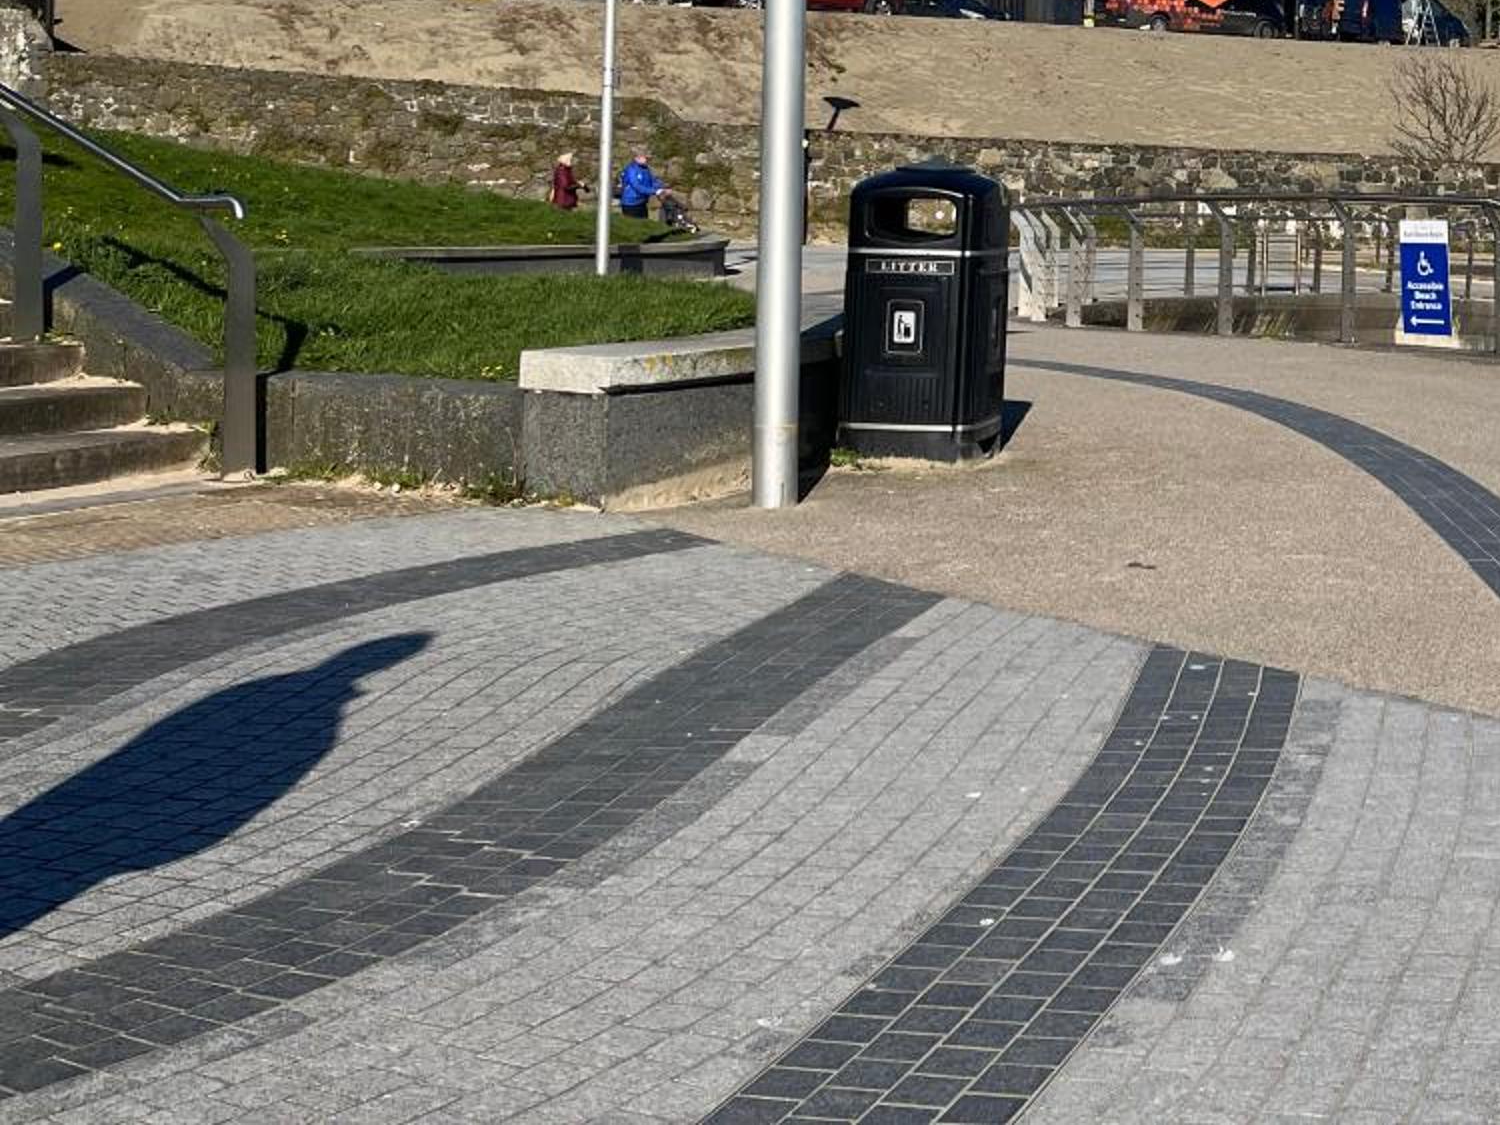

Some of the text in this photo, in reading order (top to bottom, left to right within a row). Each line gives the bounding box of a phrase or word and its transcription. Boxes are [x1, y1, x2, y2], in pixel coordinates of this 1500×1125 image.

[881, 261, 937, 272] LITTER
[1407, 281, 1444, 290] Accessible
[1414, 290, 1437, 299] Beach
[1410, 300, 1443, 310] Entrance
